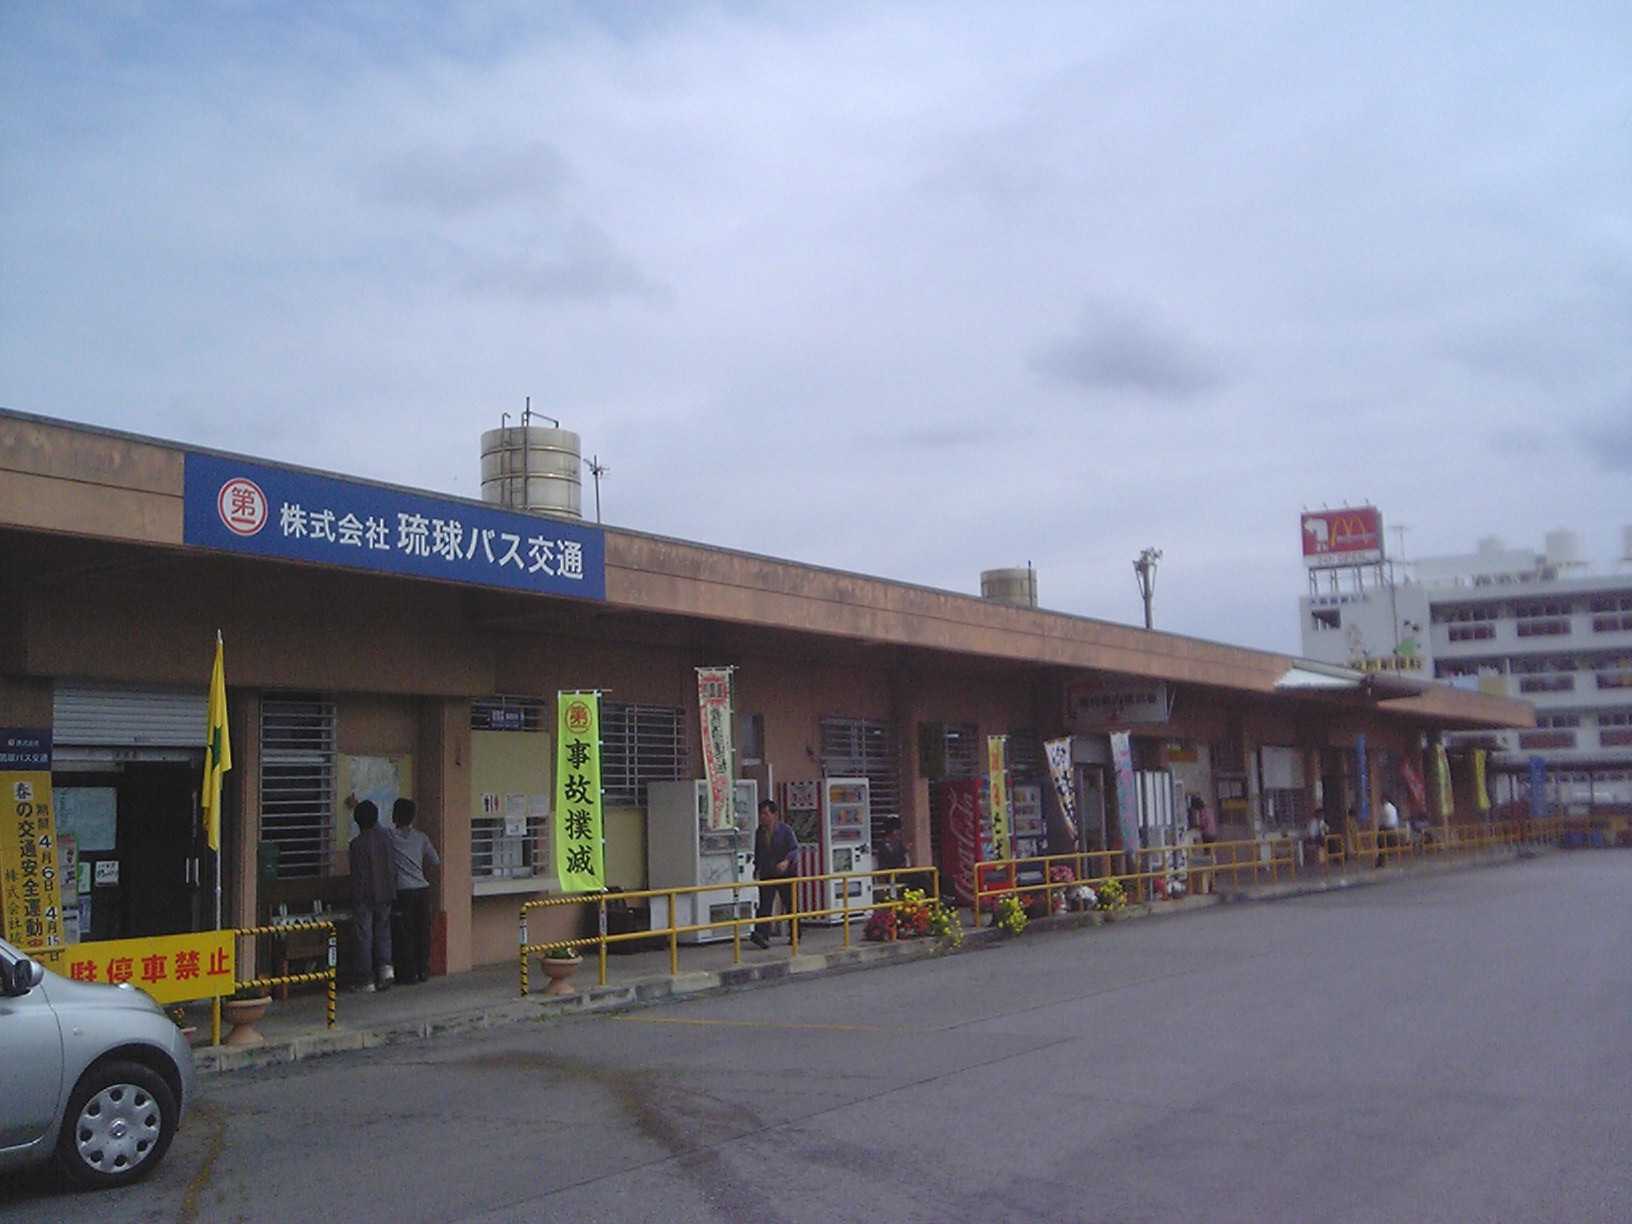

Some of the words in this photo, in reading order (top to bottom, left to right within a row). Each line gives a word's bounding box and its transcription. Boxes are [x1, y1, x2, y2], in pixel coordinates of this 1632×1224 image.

[564, 738, 595, 876] 事故撲滅
[70, 946, 231, 984] 駐停車禁止
